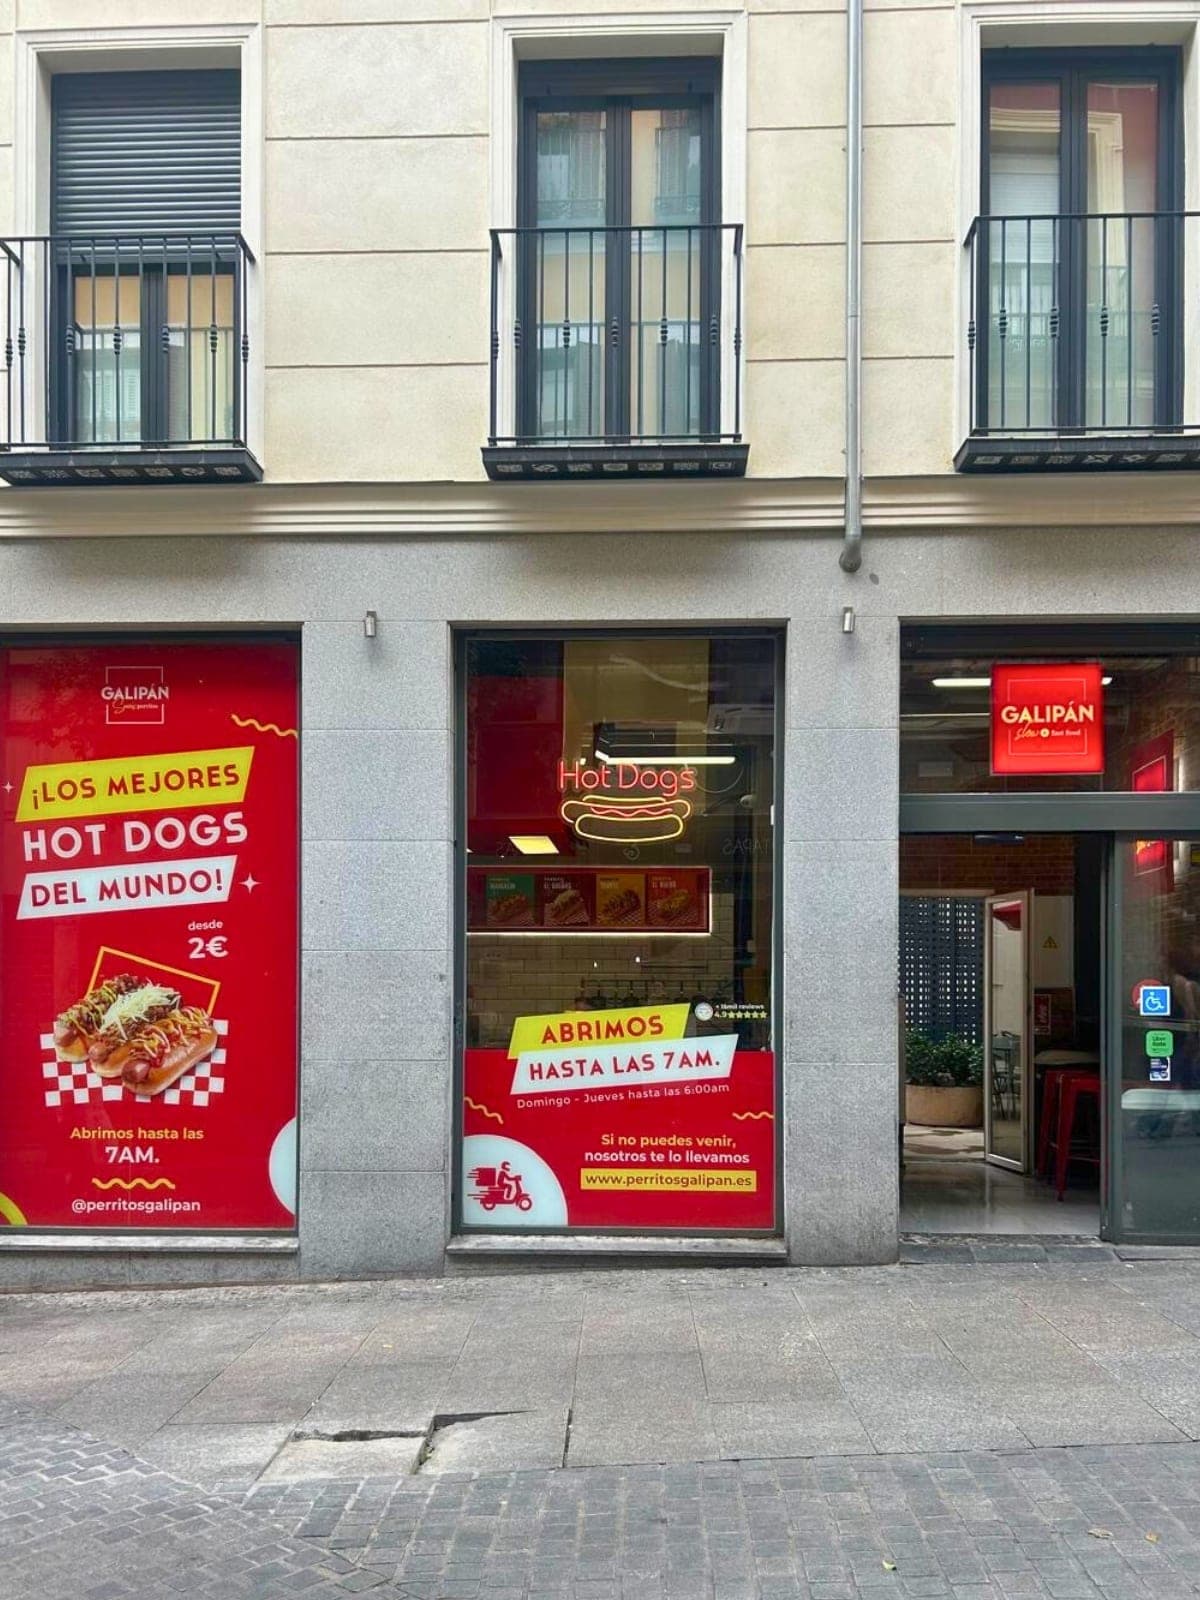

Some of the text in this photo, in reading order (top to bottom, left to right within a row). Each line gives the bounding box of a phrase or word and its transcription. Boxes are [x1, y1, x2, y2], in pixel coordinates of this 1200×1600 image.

[101, 683, 169, 700] GALIPÁN
[1001, 701, 1095, 724] GALIPÁN
[32, 763, 240, 810] ¡LOS MEJORES
[559, 760, 696, 797] Hot Dogs
[23, 811, 248, 862] HOT DOGS
[31, 868, 223, 907] DEL MUNDO!
[188, 919, 223, 931] desde
[188, 935, 229, 959] 2€
[541, 1016, 664, 1044] ABRIMOS
[529, 1059, 604, 1081] HASTA
[612, 1053, 655, 1074] LAS
[516, 1096, 571, 1109] Domingo
[583, 1091, 625, 1104] Jueves
[628, 1087, 660, 1099] hasta
[664, 1086, 681, 1096] las
[684, 1083, 730, 1095] 6:00am
[70, 1127, 204, 1140] Abrimos hasta las
[601, 1134, 736, 1150] Si no puedes venir,
[105, 1146, 160, 1164] 7AM.
[584, 1150, 750, 1164] nosotros te lo llevamos
[585, 1173, 752, 1187] www.perritosgalipan.es
[71, 1197, 201, 1214] @perritosgalipan
